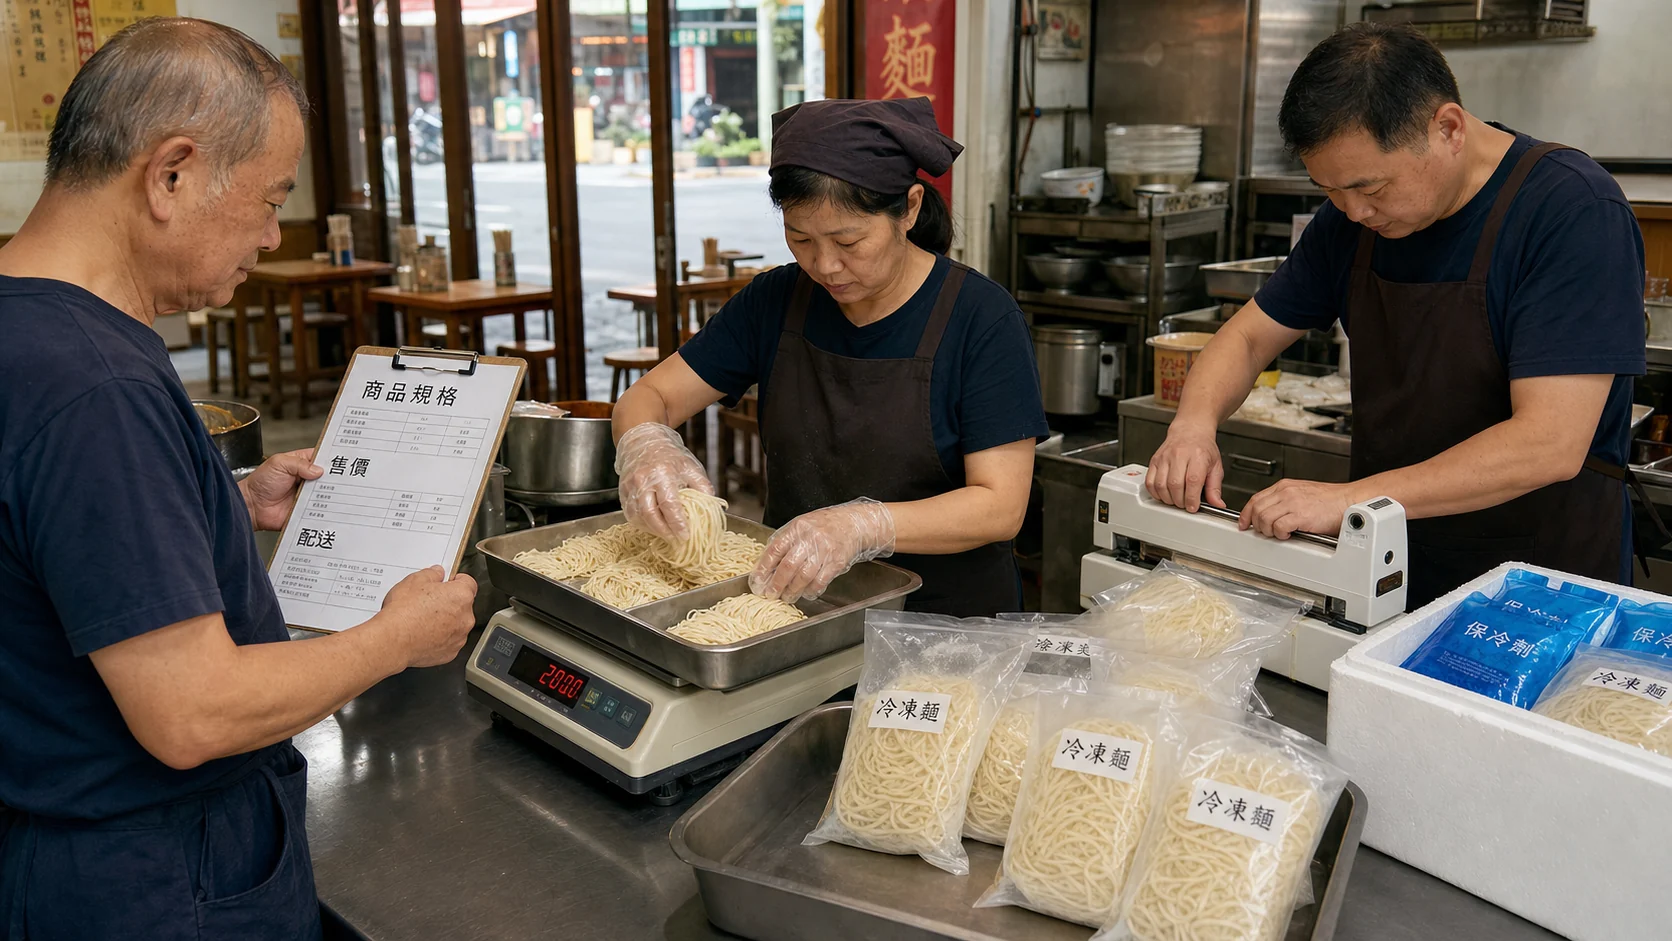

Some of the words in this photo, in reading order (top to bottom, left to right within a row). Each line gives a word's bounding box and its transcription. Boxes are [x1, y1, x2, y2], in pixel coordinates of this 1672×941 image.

[879, 0, 937, 102] 麵
[361, 379, 458, 407] 商品規格
[329, 455, 371, 478] 售價
[296, 527, 336, 550] 配送
[1464, 621, 1535, 658] 保冷劑
[539, 664, 584, 699] 2000
[876, 697, 940, 722] 冷凍麵
[1061, 738, 1132, 771] 冷凍麵
[1197, 790, 1275, 831] 冷凍麵
